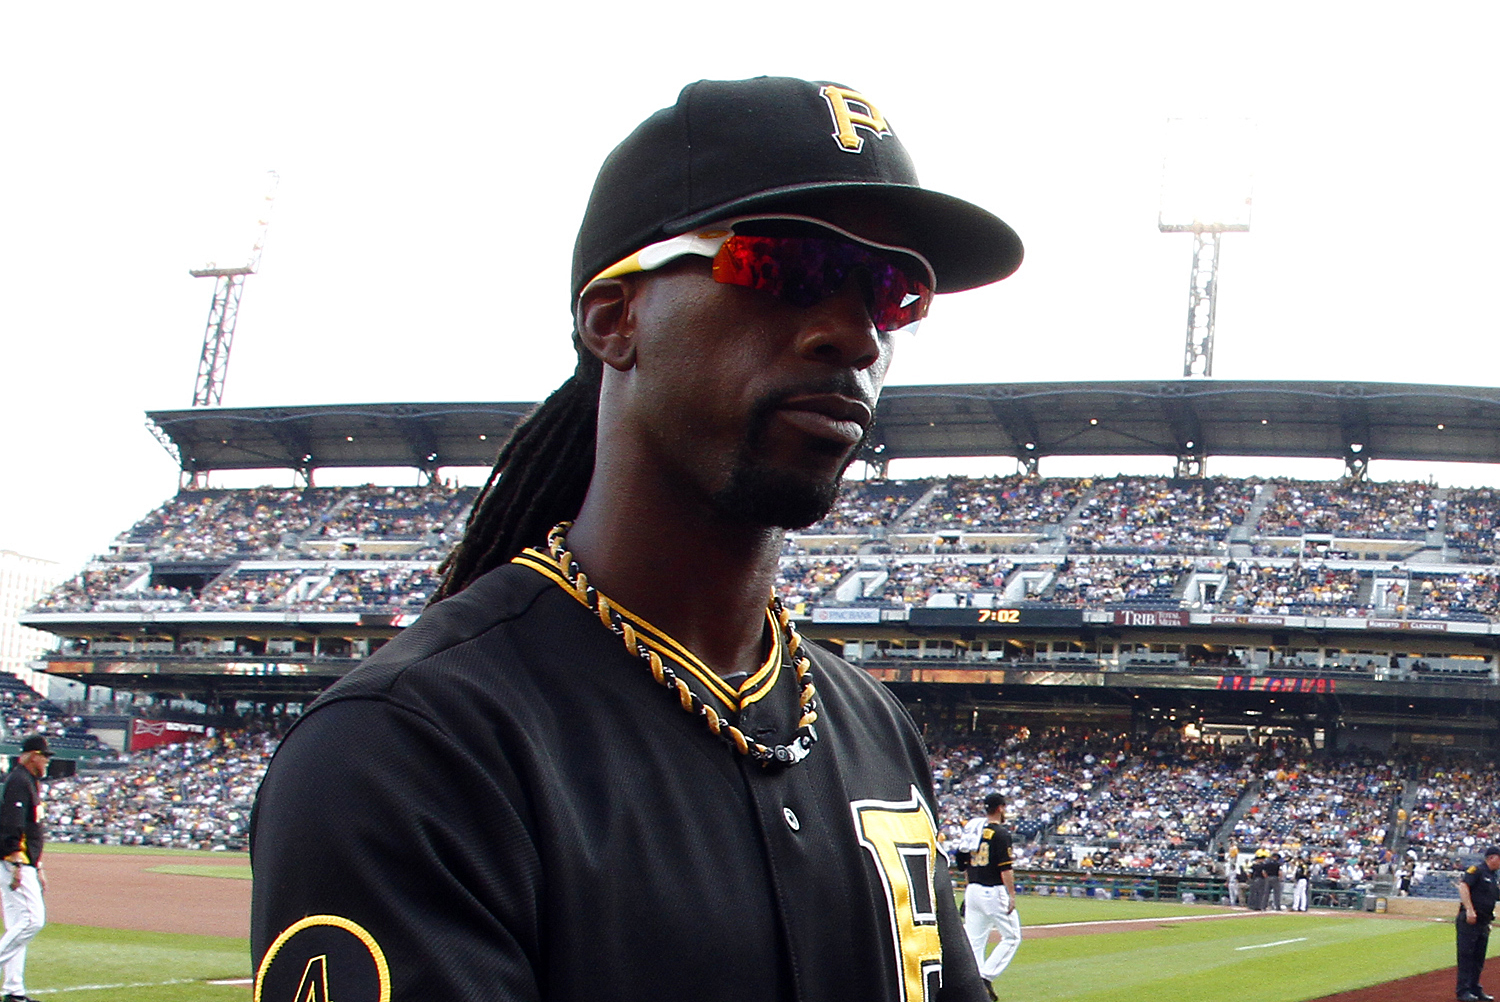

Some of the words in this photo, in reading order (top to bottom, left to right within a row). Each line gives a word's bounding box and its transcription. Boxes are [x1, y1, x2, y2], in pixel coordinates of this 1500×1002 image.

[819, 85, 892, 154] P
[978, 609, 1020, 623] 7:02
[1121, 610, 1155, 625] TRIB
[1369, 620, 1399, 629] ROBERTO
[1410, 622, 1445, 630] CLEMENTE
